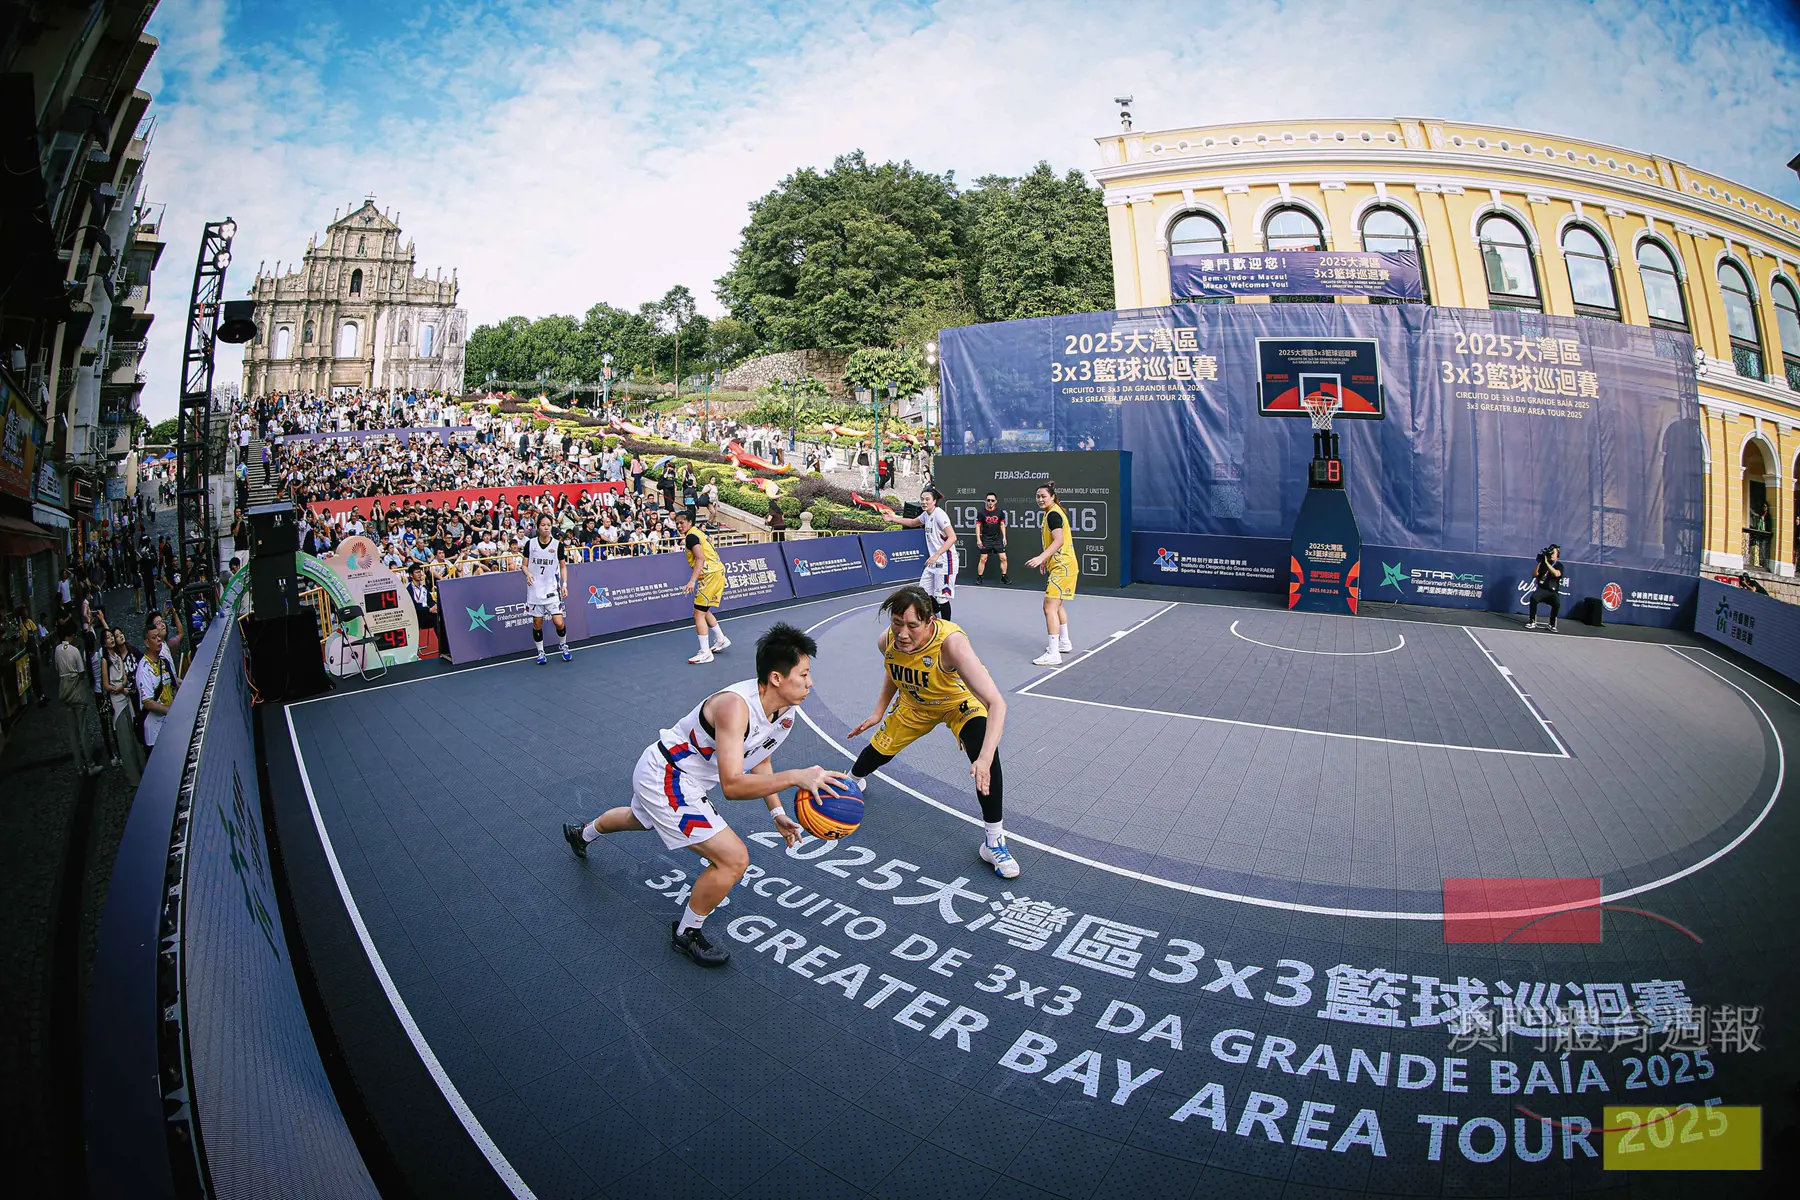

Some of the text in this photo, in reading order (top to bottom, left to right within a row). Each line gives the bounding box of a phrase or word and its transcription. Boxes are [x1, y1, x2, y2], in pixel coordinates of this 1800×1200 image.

[1202, 274, 1248, 282] Bem-vindo
[1257, 273, 1288, 281] Macau!
[1230, 281, 1270, 289] Welcomes
[1065, 327, 1199, 355] 2025大灣區
[1454, 332, 1582, 366] 2025大灣區
[1051, 355, 1218, 382] 3x3籃球巡迴賽
[1441, 361, 1599, 399] 3x3籃球巡迴賽
[1062, 386, 1094, 394] CIRCUITO
[1085, 395, 1117, 403] GREATER
[1177, 393, 1196, 401] 2025
[1455, 391, 1489, 400] CIRCUITO
[1502, 394, 1514, 402] 3x3
[1516, 395, 1526, 403] DA
[1527, 397, 1556, 405] GRANDE
[1574, 401, 1590, 409] 2025
[1480, 403, 1511, 413] GREATER
[1513, 405, 1526, 413] BAY
[1527, 407, 1546, 415] AREA
[1547, 408, 1565, 417] TOUR
[1567, 410, 1582, 419] 2025
[994, 470, 1049, 480] FIBA3x3.com
[1328, 460, 1340, 481] 8
[954, 507, 979, 528] 19
[1069, 507, 1096, 531] 16
[1086, 544, 1104, 552] FOULS
[540, 566, 545, 575] 7
[1090, 558, 1099, 572] 5
[1411, 569, 1483, 582] STARMAC
[1411, 578, 1446, 587] Entertainment
[1447, 581, 1474, 589] Production
[381, 591, 397, 608] 14
[384, 629, 407, 646] 43
[888, 663, 930, 688] WOLF
[890, 933, 971, 978] DE
[975, 965, 1081, 1016] 3x3
[1096, 1000, 1183, 1050] DA
[1211, 1029, 1468, 1092] GRANDE
[1491, 1052, 1609, 1095] BAÍA
[1622, 1049, 1716, 1089] 2025
[726, 915, 989, 1052] GREATER
[999, 1030, 1162, 1106] BAY
[1170, 1083, 1387, 1157] AREA
[1417, 1115, 1598, 1162] TOUR
[1616, 1098, 1728, 1154] 2025
